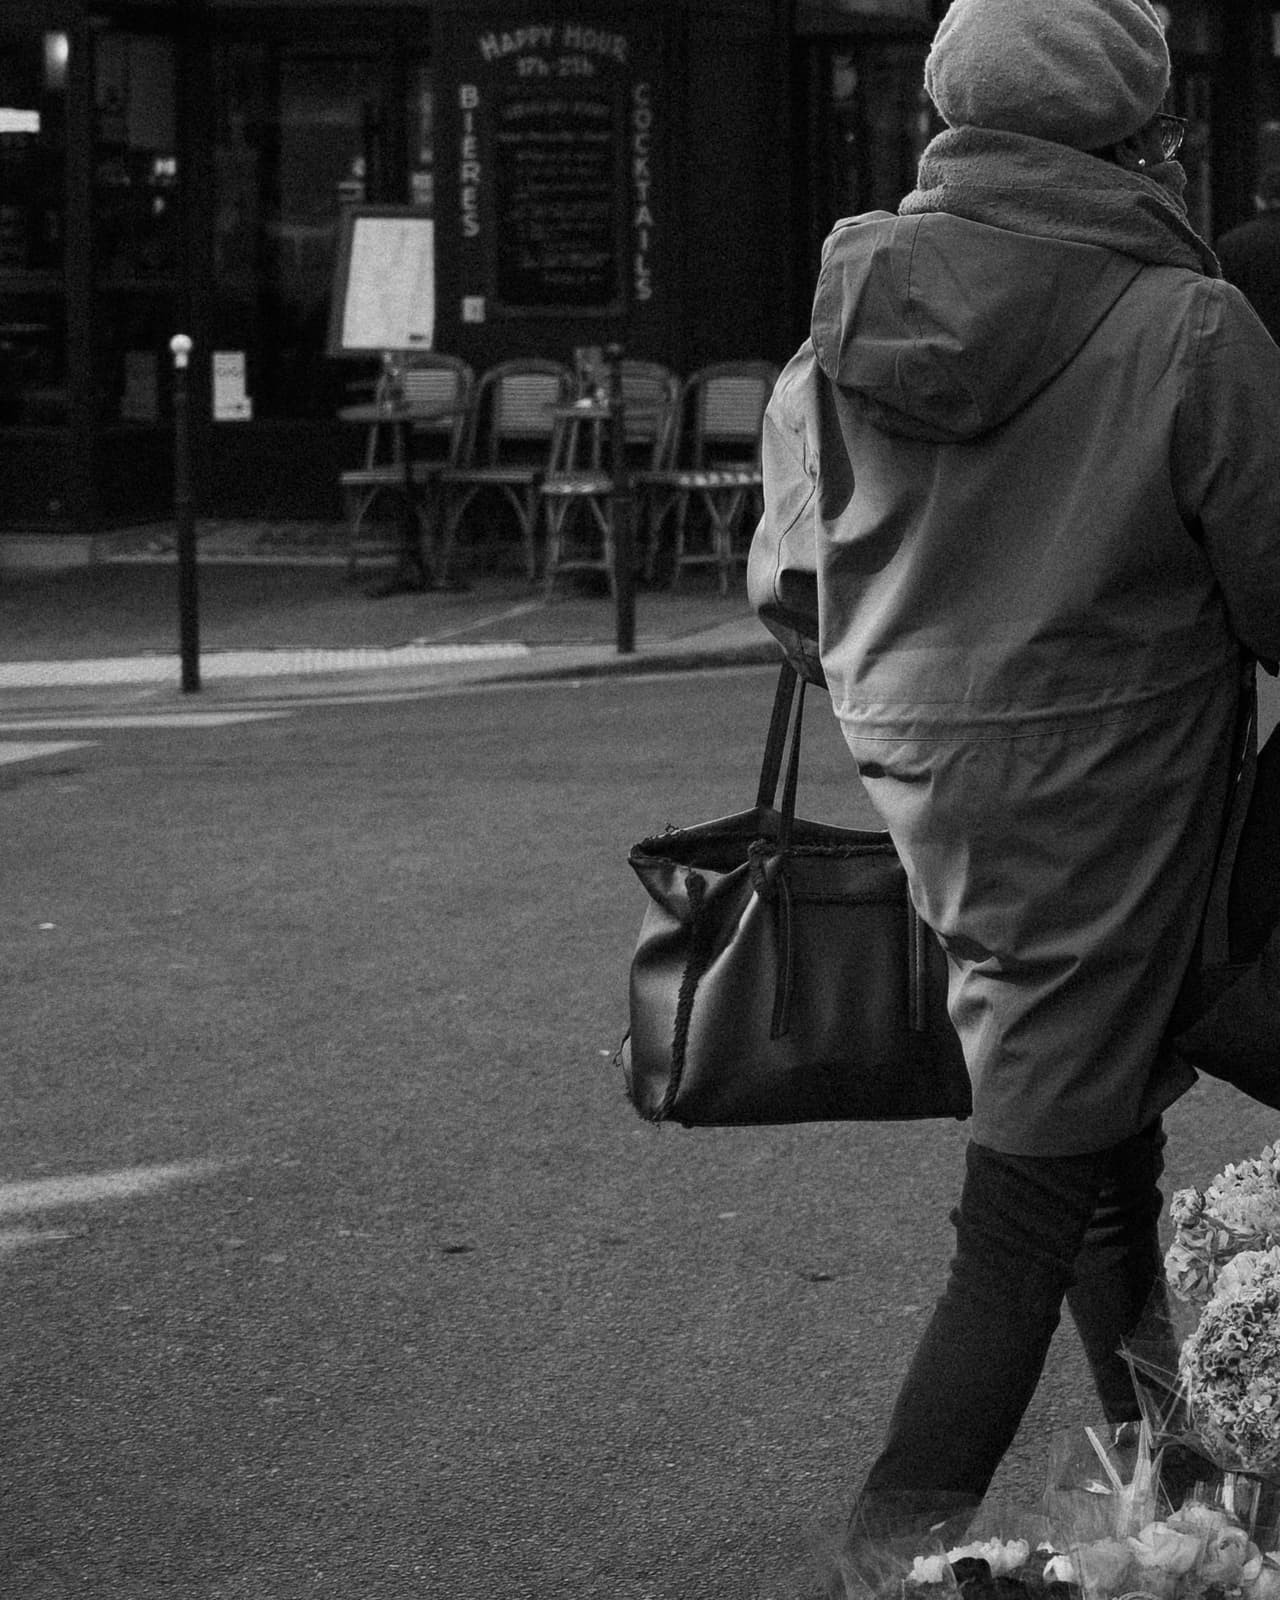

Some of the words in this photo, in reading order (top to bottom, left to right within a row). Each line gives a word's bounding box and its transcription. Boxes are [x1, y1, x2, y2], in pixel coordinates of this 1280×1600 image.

[478, 25, 555, 62] HAPPY
[563, 24, 629, 63] HOUR
[632, 82, 655, 301] COCKTAILS
